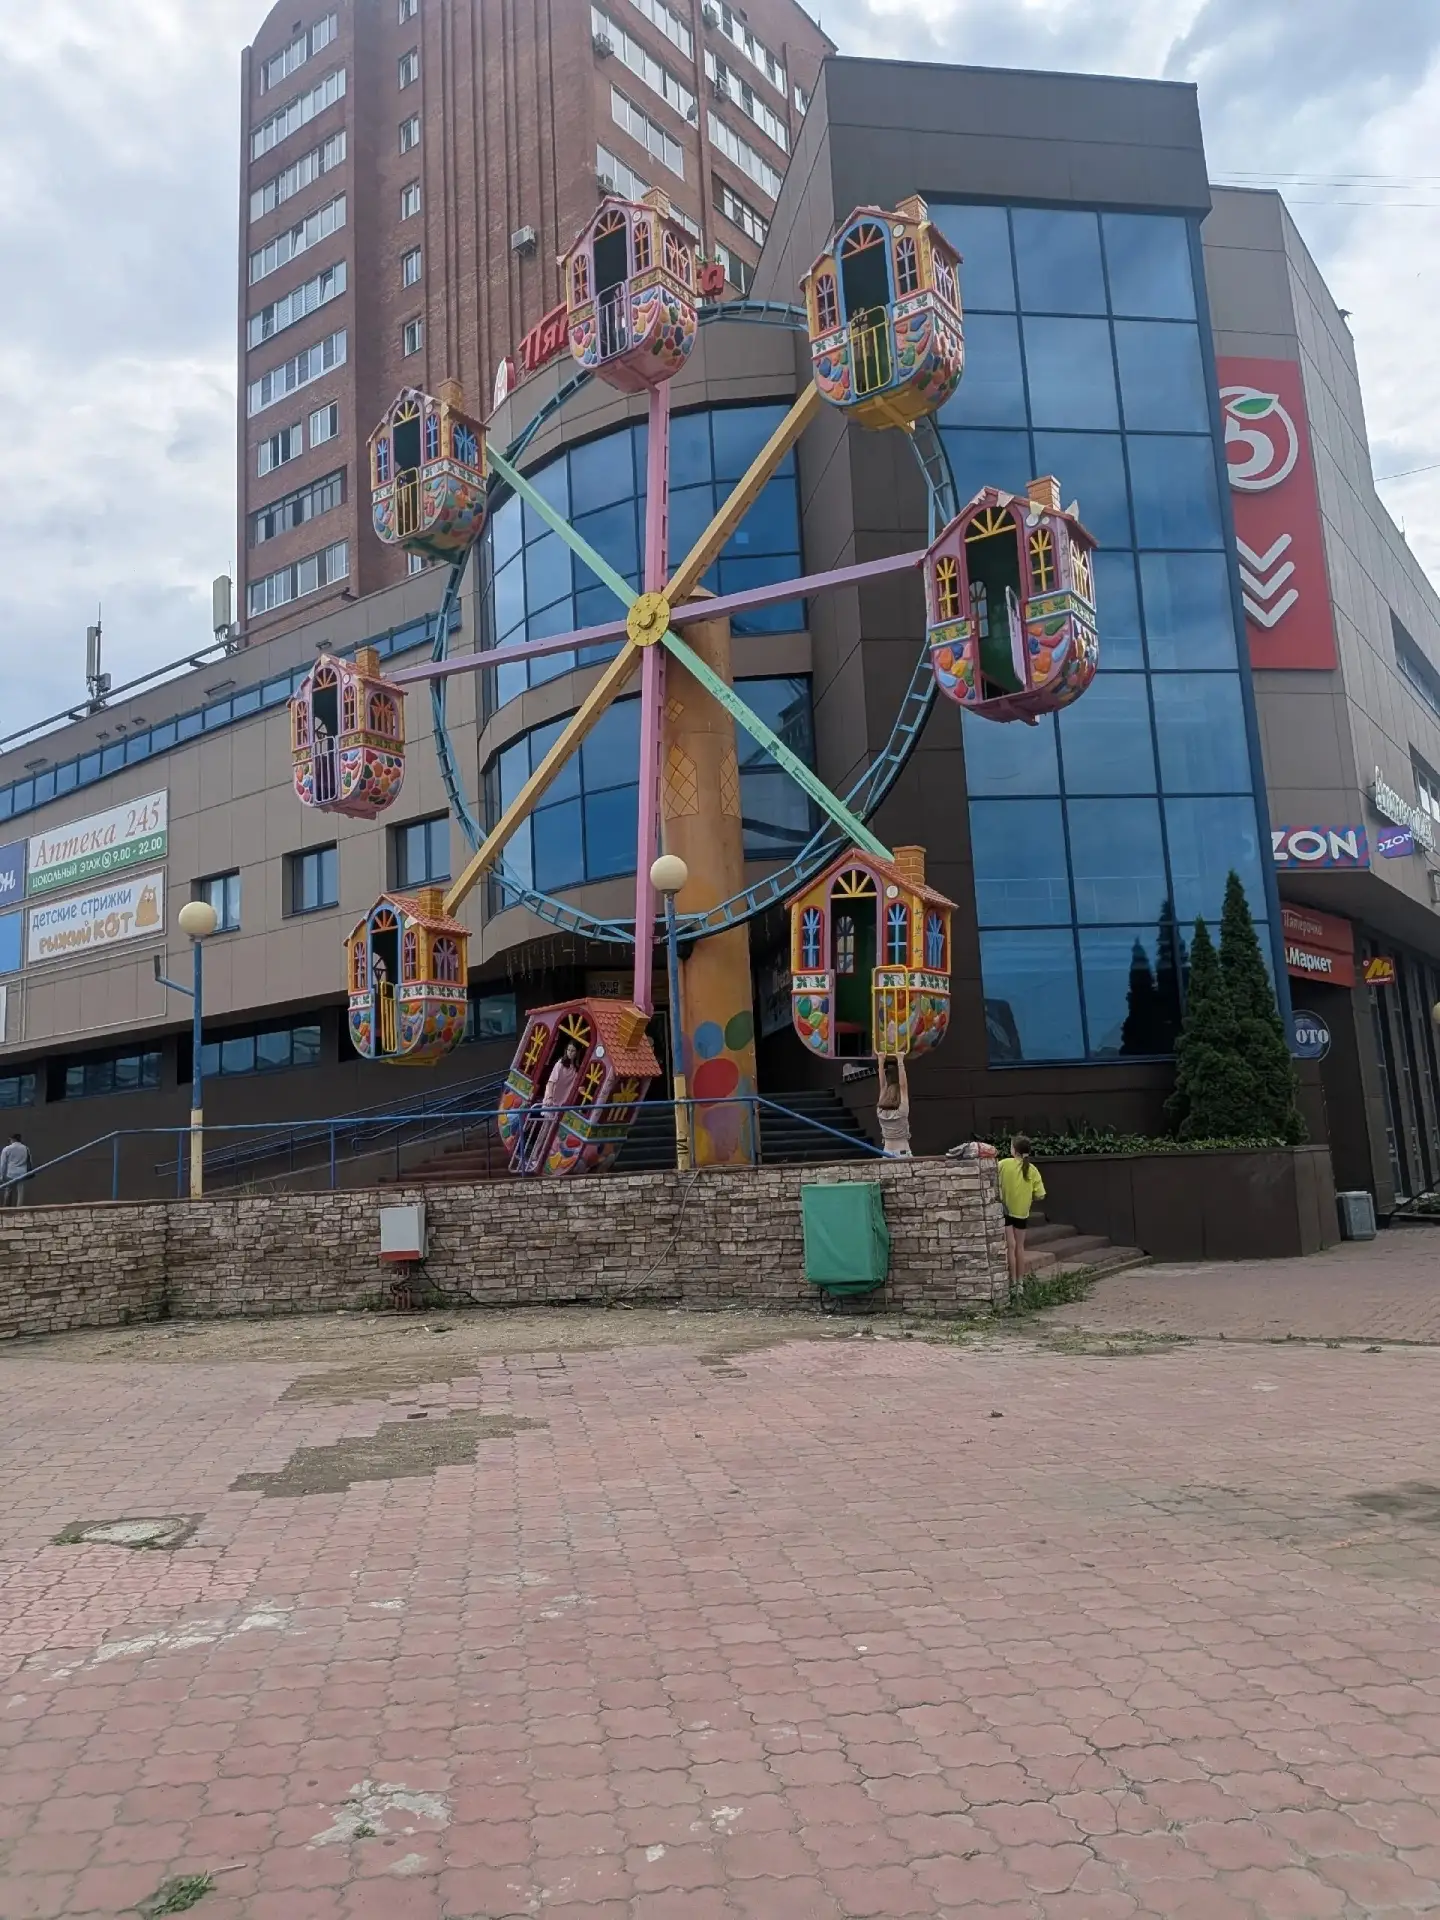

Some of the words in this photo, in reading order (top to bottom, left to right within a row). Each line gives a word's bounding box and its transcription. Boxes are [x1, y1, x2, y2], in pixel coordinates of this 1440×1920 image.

[33, 823, 117, 868] Аптека
[125, 798, 161, 838] 245
[32, 864, 78, 888] ЦОКОЛЬНЫЙ
[79, 859, 101, 874] ЭТАЖ
[111, 847, 131, 863] 9.00
[139, 836, 163, 855] 22.00
[80, 888, 132, 919] стрижки
